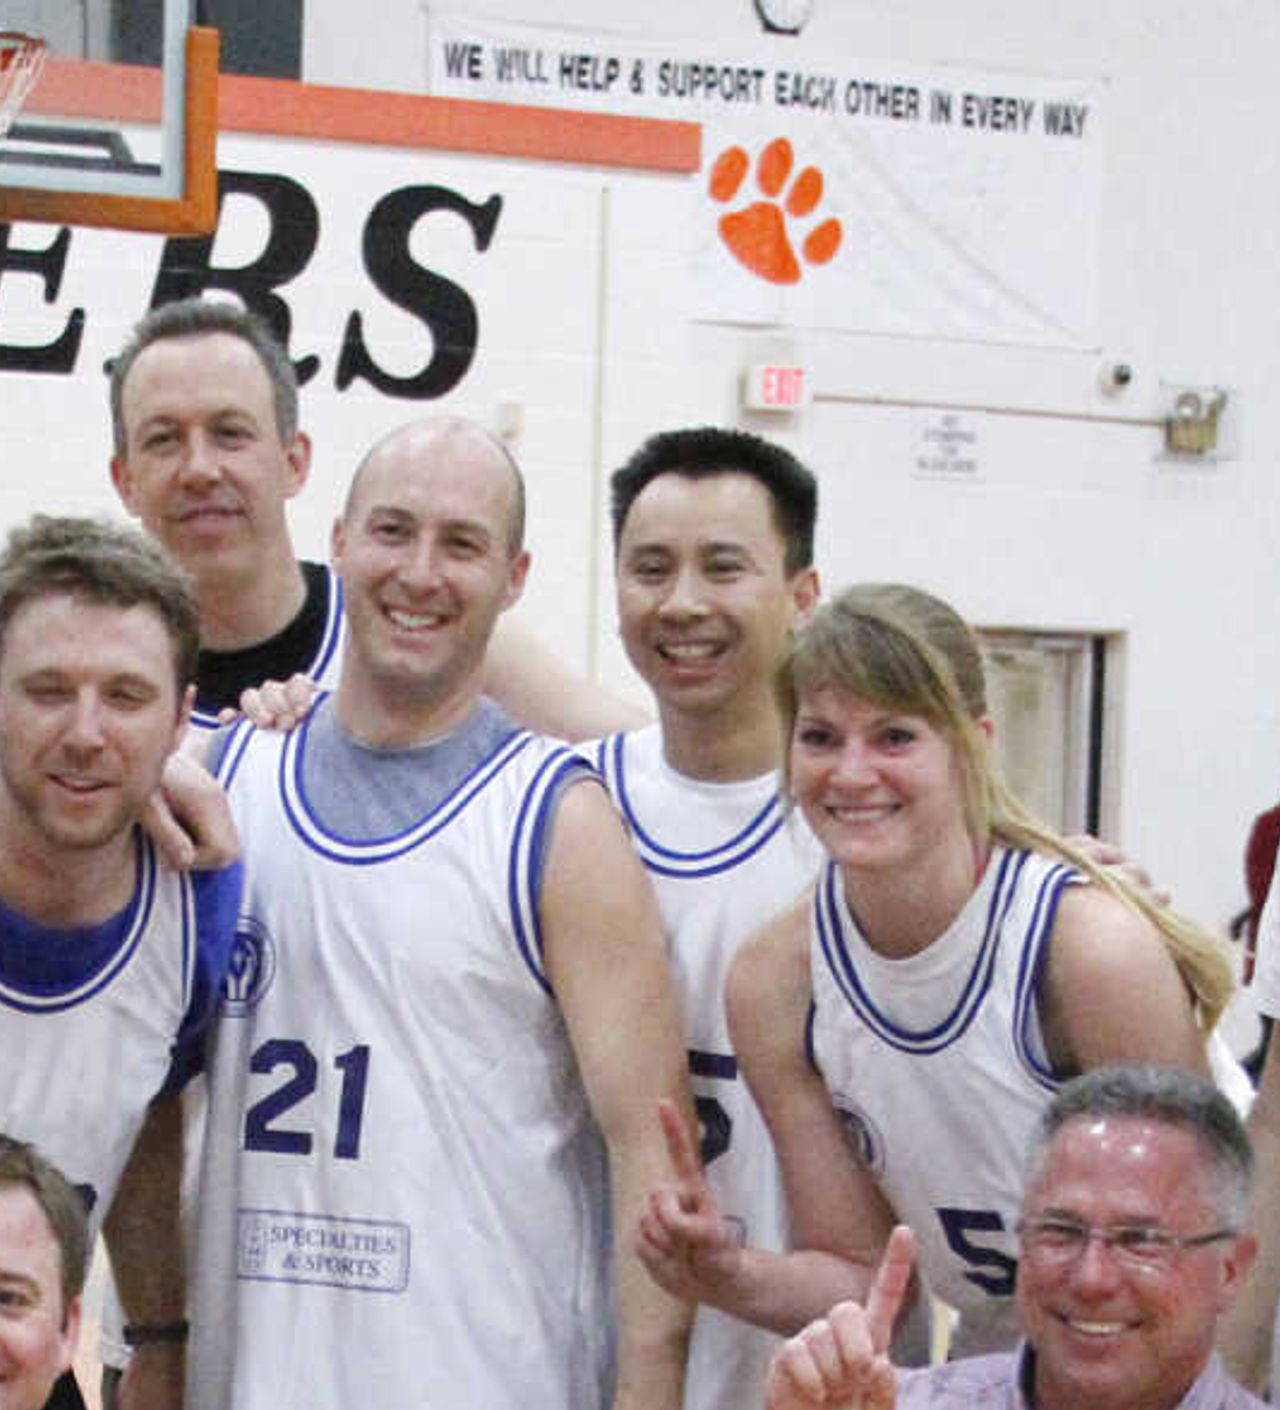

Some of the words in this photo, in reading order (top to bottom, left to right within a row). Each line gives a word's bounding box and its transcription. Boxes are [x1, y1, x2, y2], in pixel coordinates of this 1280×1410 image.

[443, 41, 483, 80] WE
[493, 47, 549, 84] WILL
[558, 52, 620, 93] HELP
[629, 59, 645, 95] &
[657, 60, 765, 102] SUPPORT
[774, 70, 837, 112] EACH
[843, 78, 921, 122] OTHER
[929, 88, 953, 124] IN
[961, 93, 1036, 134] EVERY
[1042, 100, 1088, 138] WAY
[763, 366, 804, 405] EXIT
[243, 1038, 371, 1160] 21
[269, 1225, 398, 1254] SPECIALTIES
[305, 1253, 382, 1278] SPORTS
[936, 1208, 1019, 1296] 5
